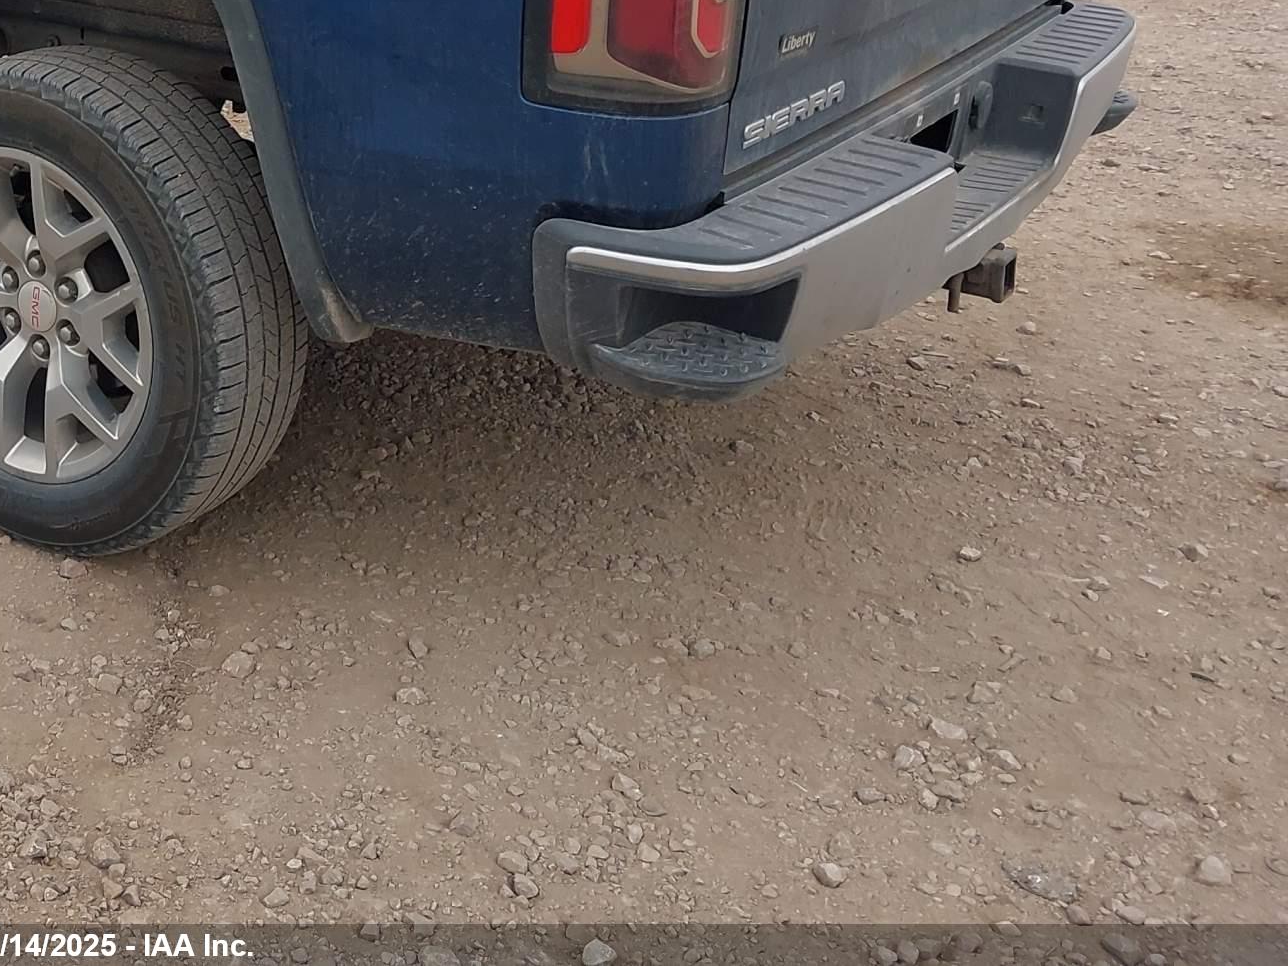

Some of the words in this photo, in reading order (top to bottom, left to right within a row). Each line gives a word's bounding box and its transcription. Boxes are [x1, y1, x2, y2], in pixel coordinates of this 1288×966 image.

[781, 31, 816, 53] Liberty
[742, 80, 846, 150] SIERRA
[31, 286, 41, 329] GMC
